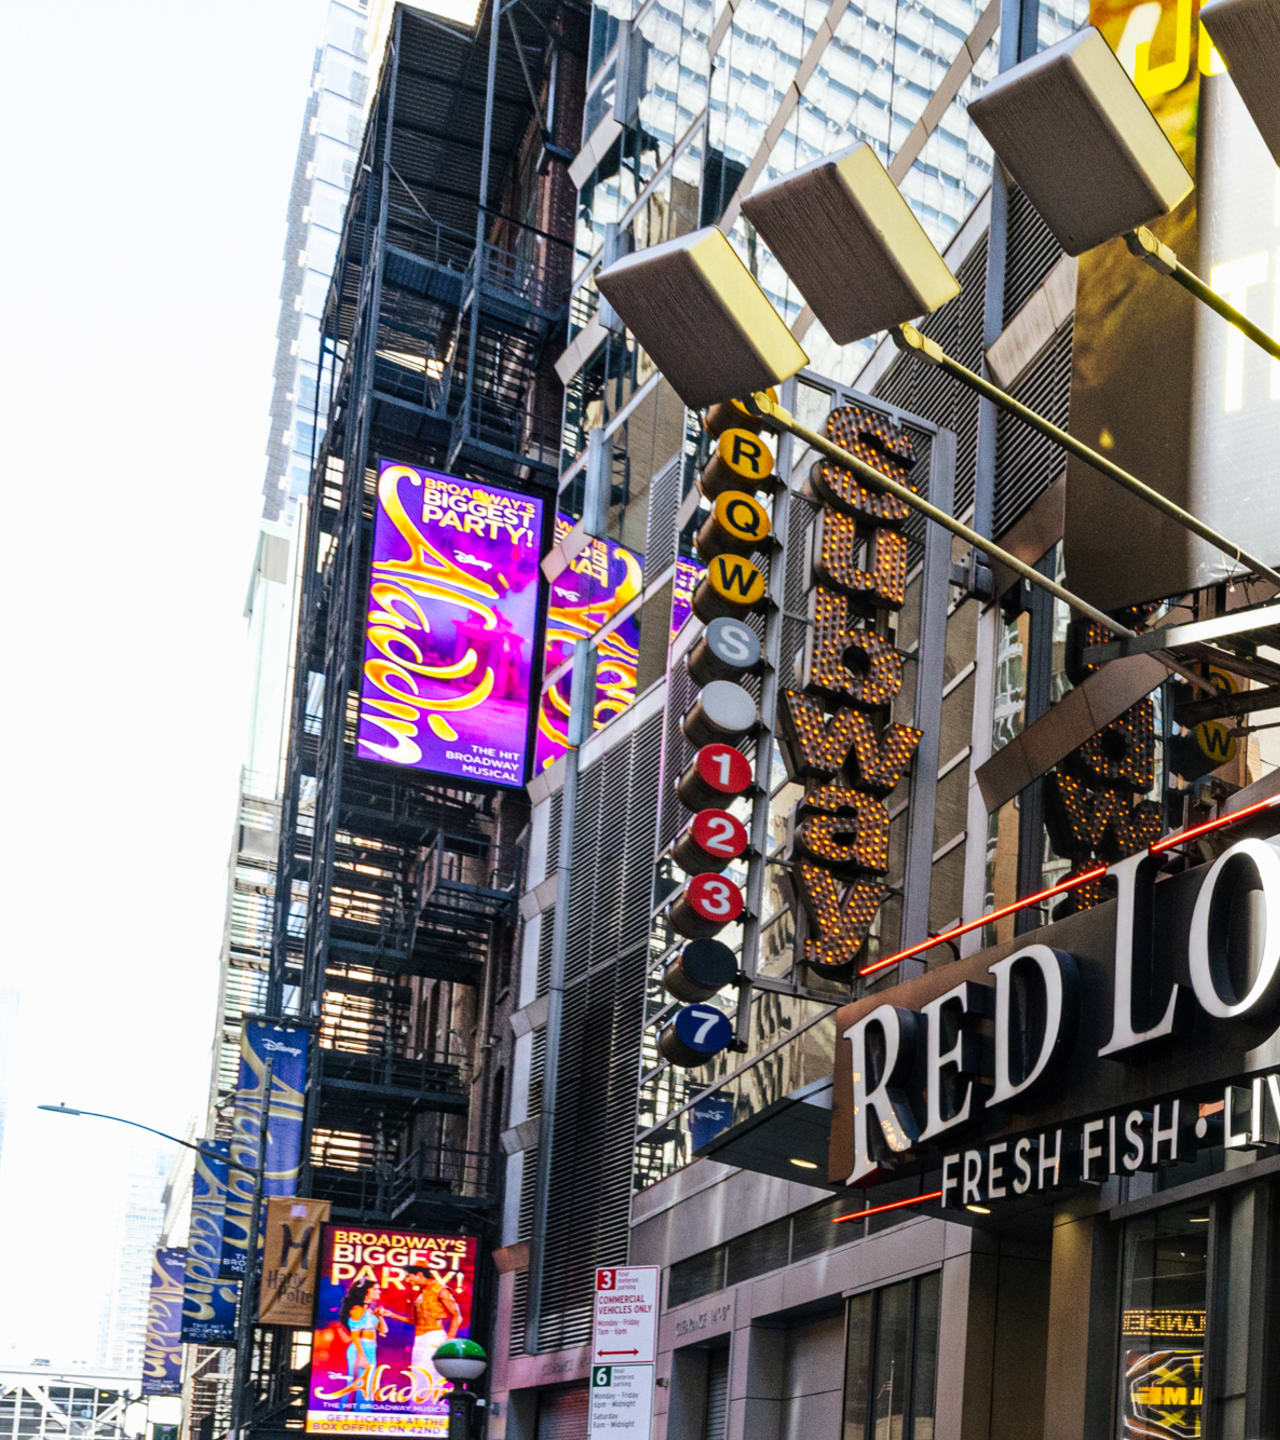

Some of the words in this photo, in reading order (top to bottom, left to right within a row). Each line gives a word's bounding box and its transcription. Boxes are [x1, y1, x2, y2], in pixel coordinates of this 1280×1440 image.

[731, 435, 761, 474] R
[424, 489, 535, 529] BIGGEST
[425, 477, 535, 514] BROADWAY'S
[422, 504, 534, 548] PARTY!
[726, 500, 758, 537] Q
[717, 558, 758, 596] W
[718, 625, 749, 660] S
[446, 751, 519, 771] BROADWAY
[471, 745, 497, 758] THE
[500, 748, 520, 760] HIT
[463, 764, 518, 782] MUSICAL
[712, 753, 731, 785] 1
[706, 818, 735, 852] 2
[701, 881, 730, 914] 3
[690, 1010, 720, 1044] 7
[845, 944, 1064, 1188] RED
[940, 1129, 1063, 1208] FRESH
[1082, 1099, 1181, 1179] FISH
[333, 1244, 467, 1271] BIGGEST
[334, 1230, 467, 1253] BROADWAY'S
[331, 1263, 465, 1294] PARY!
[601, 1271, 612, 1289] 3
[599, 1295, 645, 1304] COMMERCIAL
[599, 1305, 632, 1315] VEHICLES
[634, 1304, 652, 1313] ONLY
[314, 1364, 454, 1404] Aladdi
[596, 1367, 607, 1386] 6
[327, 1414, 351, 1423] GET
[354, 1415, 401, 1424] TICKETS
[407, 1417, 423, 1425] AT
[425, 1417, 446, 1426] THE
[360, 1403, 411, 1412] BROADWAY
[413, 1405, 449, 1413] MUSICA
[312, 1422, 337, 1431] BOX
[341, 1422, 384, 1433] OFFICE
[388, 1425, 405, 1433] ON
[408, 1426, 440, 1435] 42ND
